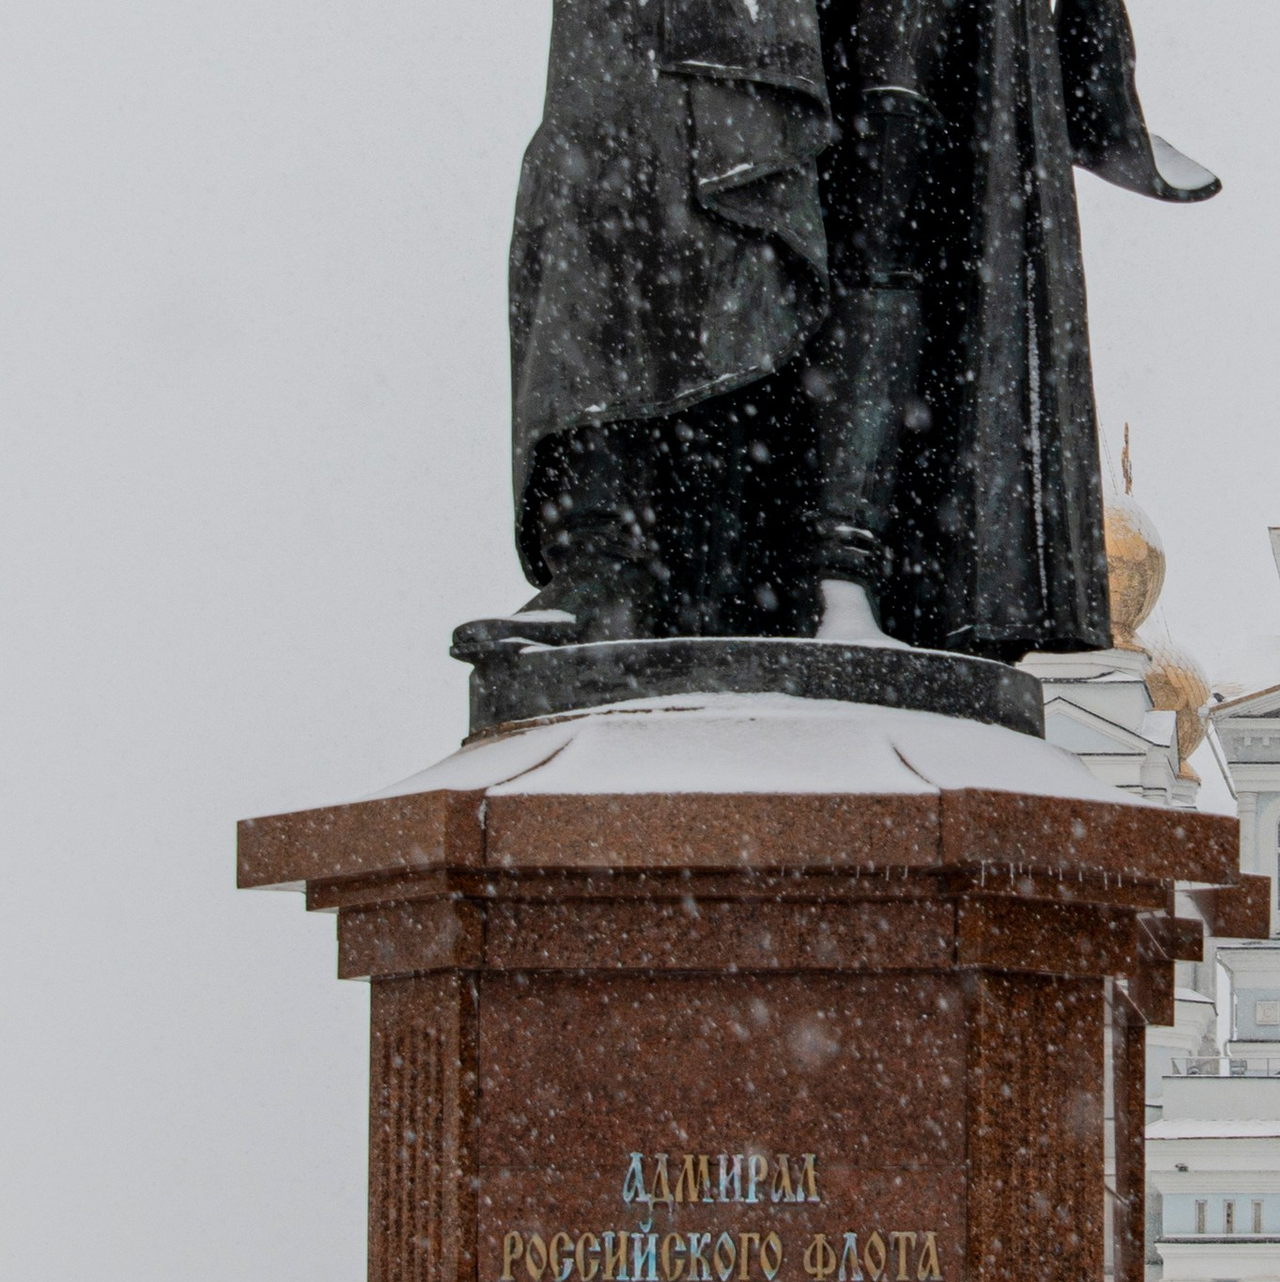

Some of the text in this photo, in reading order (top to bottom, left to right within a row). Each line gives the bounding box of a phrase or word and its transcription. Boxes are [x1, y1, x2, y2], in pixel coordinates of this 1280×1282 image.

[622, 1152, 821, 1214] АДМИРАЛ
[501, 1219, 943, 1282] РОССИЙСКОГО ФЛОТА
